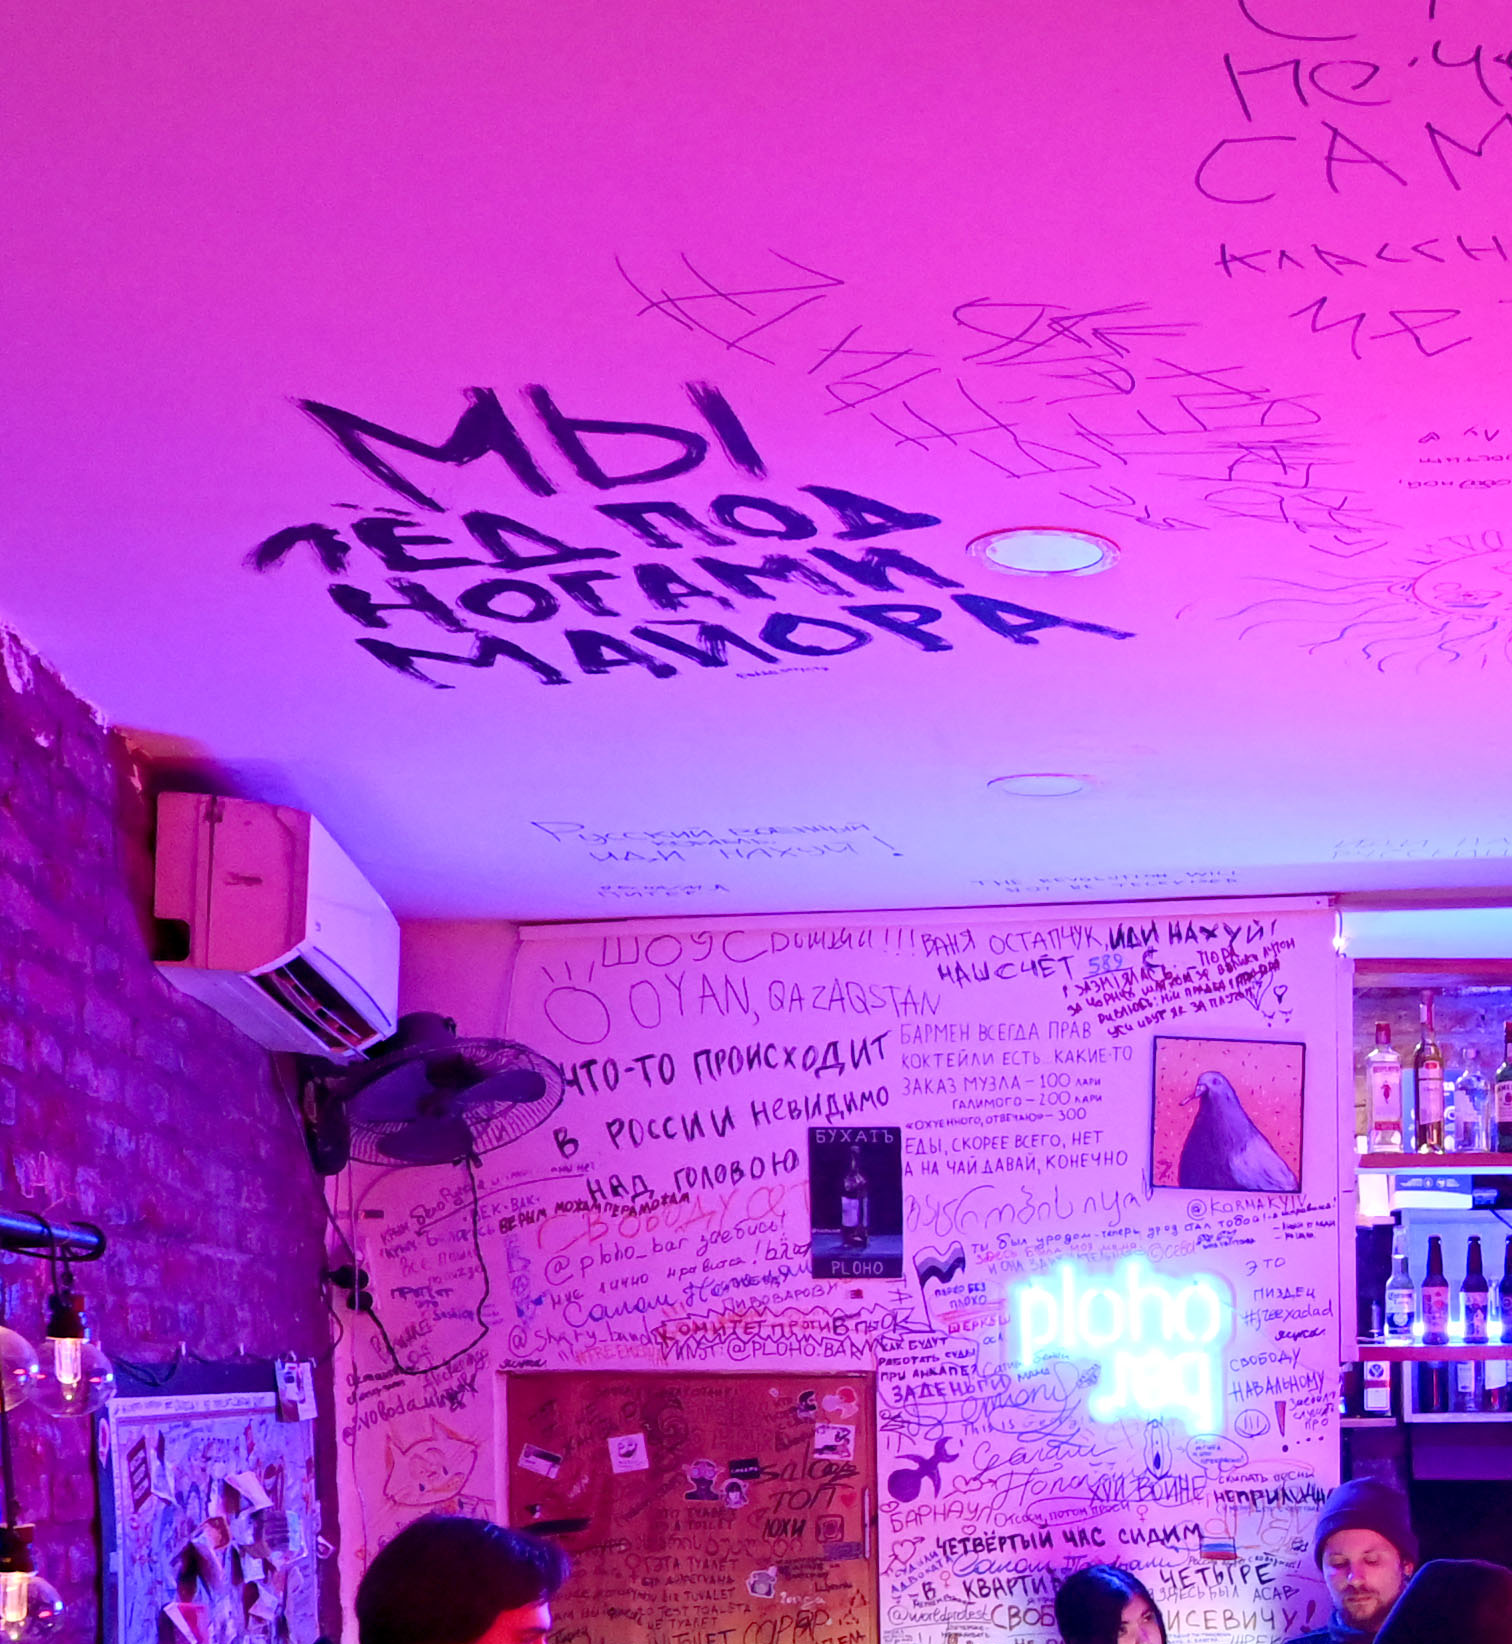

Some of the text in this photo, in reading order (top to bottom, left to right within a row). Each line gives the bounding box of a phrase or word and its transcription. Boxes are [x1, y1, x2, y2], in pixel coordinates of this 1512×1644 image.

[289, 378, 768, 513] МЫ
[242, 483, 941, 576] ЛЁД ПОД
[327, 547, 964, 633] НОГАМИ
[355, 592, 1138, 691] МАЙОРА
[921, 929, 975, 957] ВАНЯ
[1109, 920, 1158, 950] ИДИ
[1088, 953, 1124, 974] 589
[768, 977, 941, 1018] QAZAQSTAN
[900, 1019, 1092, 1046] БАРМЕН ВСЕГДА ПРАВ
[561, 1030, 892, 1098] ЧТО-ТО ПРОИСХОДИТ
[901, 1044, 1134, 1071] КОКТЕЙЛИ ЕСТЬ КАКИЕ-ТО
[903, 1076, 958, 1096] ЗАКАЗ
[963, 1074, 1021, 1093] МУЗЛА
[1039, 1072, 1072, 1089] 100
[951, 1093, 1023, 1111] ГАЛИМОГО
[1039, 1090, 1072, 1107] 200
[1058, 1106, 1088, 1122] 300
[554, 1127, 578, 1159] В
[606, 1106, 733, 1150] РОССИИ
[814, 1128, 894, 1145] БУХАТЬ
[905, 1129, 1103, 1157] ЕДЫ, СКОРЕЕ ВСЕГО, НЕТ
[587, 1147, 799, 1202] НАД ГОЛОВОЮ
[905, 1149, 1129, 1177] А НА ЧАЙ ДАВАЙ, КОНЕЧНО
[831, 1261, 884, 1275] PLOHO
[1245, 1257, 1286, 1277] ЭТО
[1253, 1287, 1316, 1302] ПИЗДЕЦ
[1020, 1263, 1221, 1367] ploho
[656, 1315, 849, 1348] КОМИТЕТ ПРОТИВ
[908, 1336, 949, 1351] БУДУТ
[878, 1355, 940, 1367] РАБОТАТЬ
[1229, 1348, 1301, 1371] СВОБОДУ
[880, 1369, 906, 1382] ПРИ
[1228, 1371, 1325, 1402] НАВАЛЬНОМУ
[889, 1501, 993, 1534] БАРНАУЛ
[936, 1523, 1204, 1556] ЧЕТВЁРТЫЙ ЧАС СИДИМ
[962, 1574, 1062, 1600] КВАРТИ
[1160, 1563, 1276, 1590] ЧЕТЫРЕ
[990, 1604, 1057, 1631] СВОБ
[1167, 1600, 1317, 1634] ИСЕВИЧУ!
